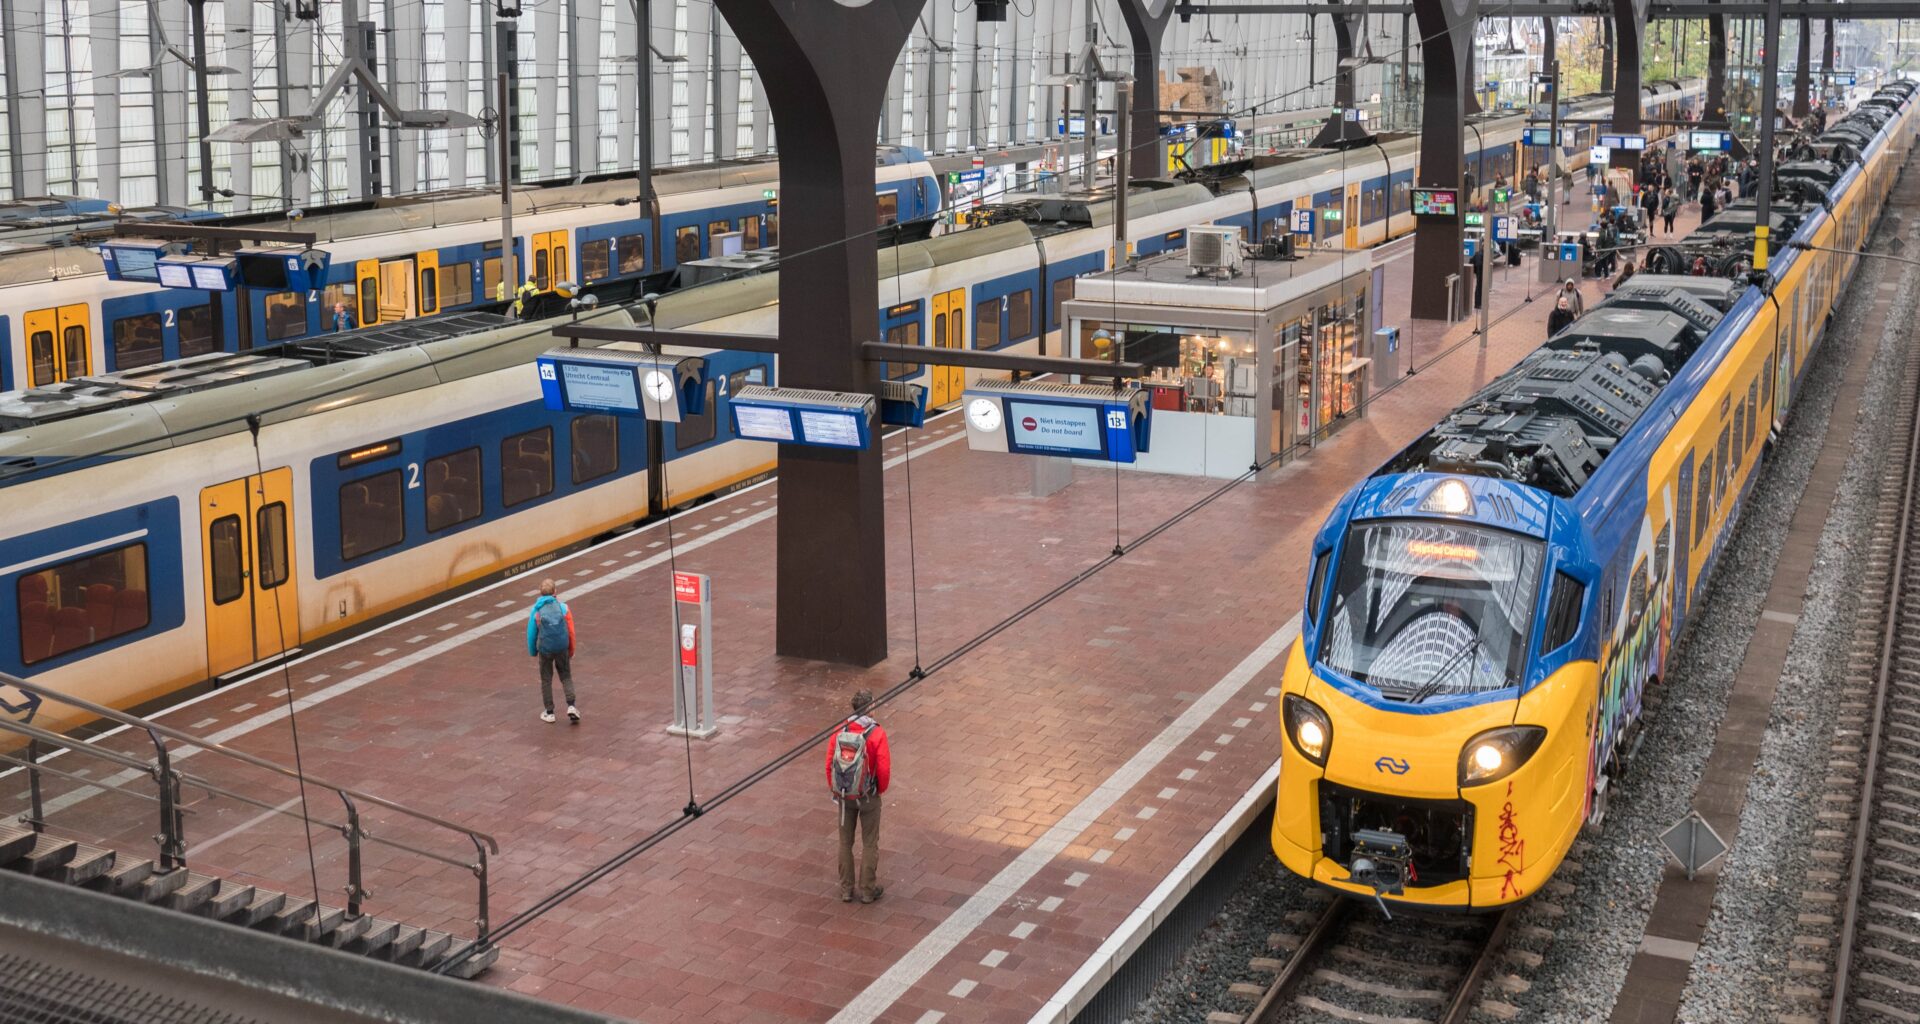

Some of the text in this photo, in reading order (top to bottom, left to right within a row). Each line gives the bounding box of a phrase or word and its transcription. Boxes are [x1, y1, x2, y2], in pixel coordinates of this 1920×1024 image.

[760, 213, 766, 226] 2
[610, 237, 617, 251] 2
[1002, 295, 1008, 312] 2
[164, 309, 175, 328] 2
[565, 372, 586, 380] Utrecht
[718, 374, 727, 397] 2
[1040, 417, 1086, 429] Niet instappen
[1063, 428, 1083, 436] board
[407, 462, 420, 489] 2
